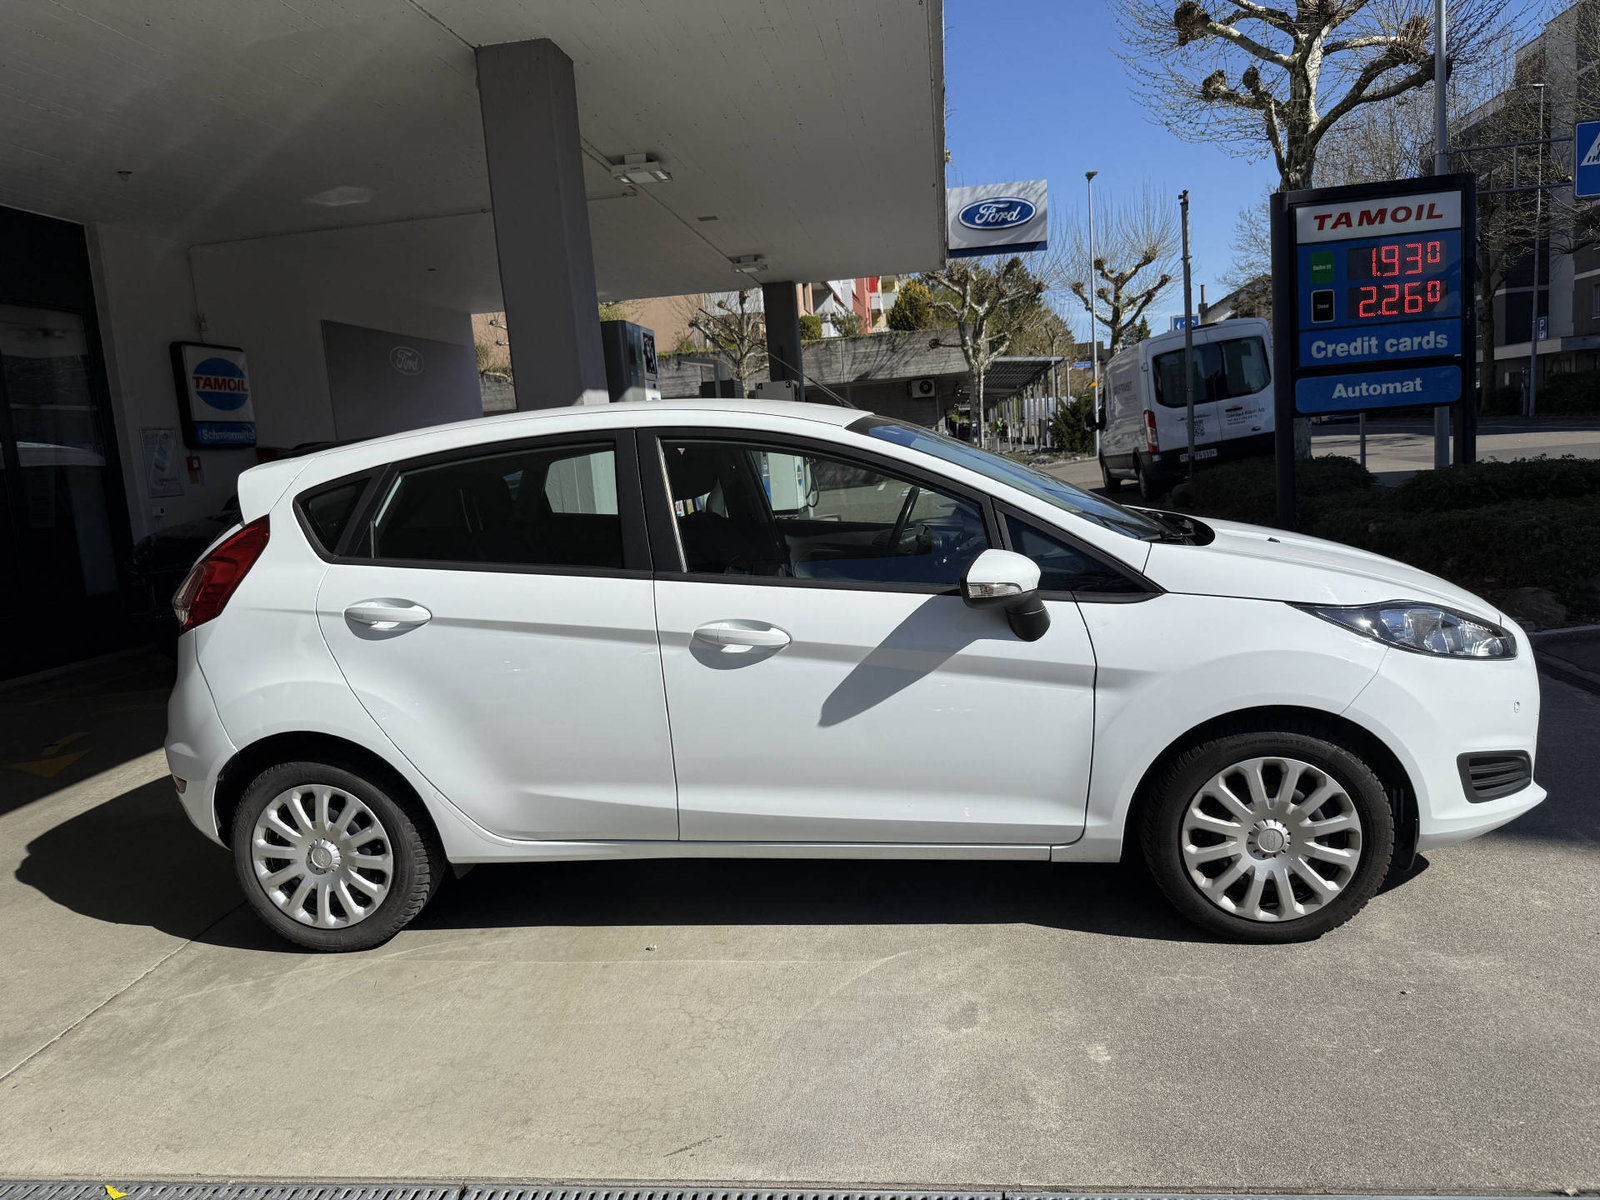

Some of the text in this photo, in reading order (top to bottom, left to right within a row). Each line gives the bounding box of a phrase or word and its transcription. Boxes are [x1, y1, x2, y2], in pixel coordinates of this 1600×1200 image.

[974, 202, 1022, 224] Ford
[1313, 203, 1443, 231] TAMOIL
[1539, 319, 1545, 331] P
[1311, 331, 1448, 359] Credit cards
[396, 349, 419, 371] Ford
[192, 376, 248, 392] TAMOIL
[785, 380, 792, 388] 3
[1332, 377, 1422, 399] Automat
